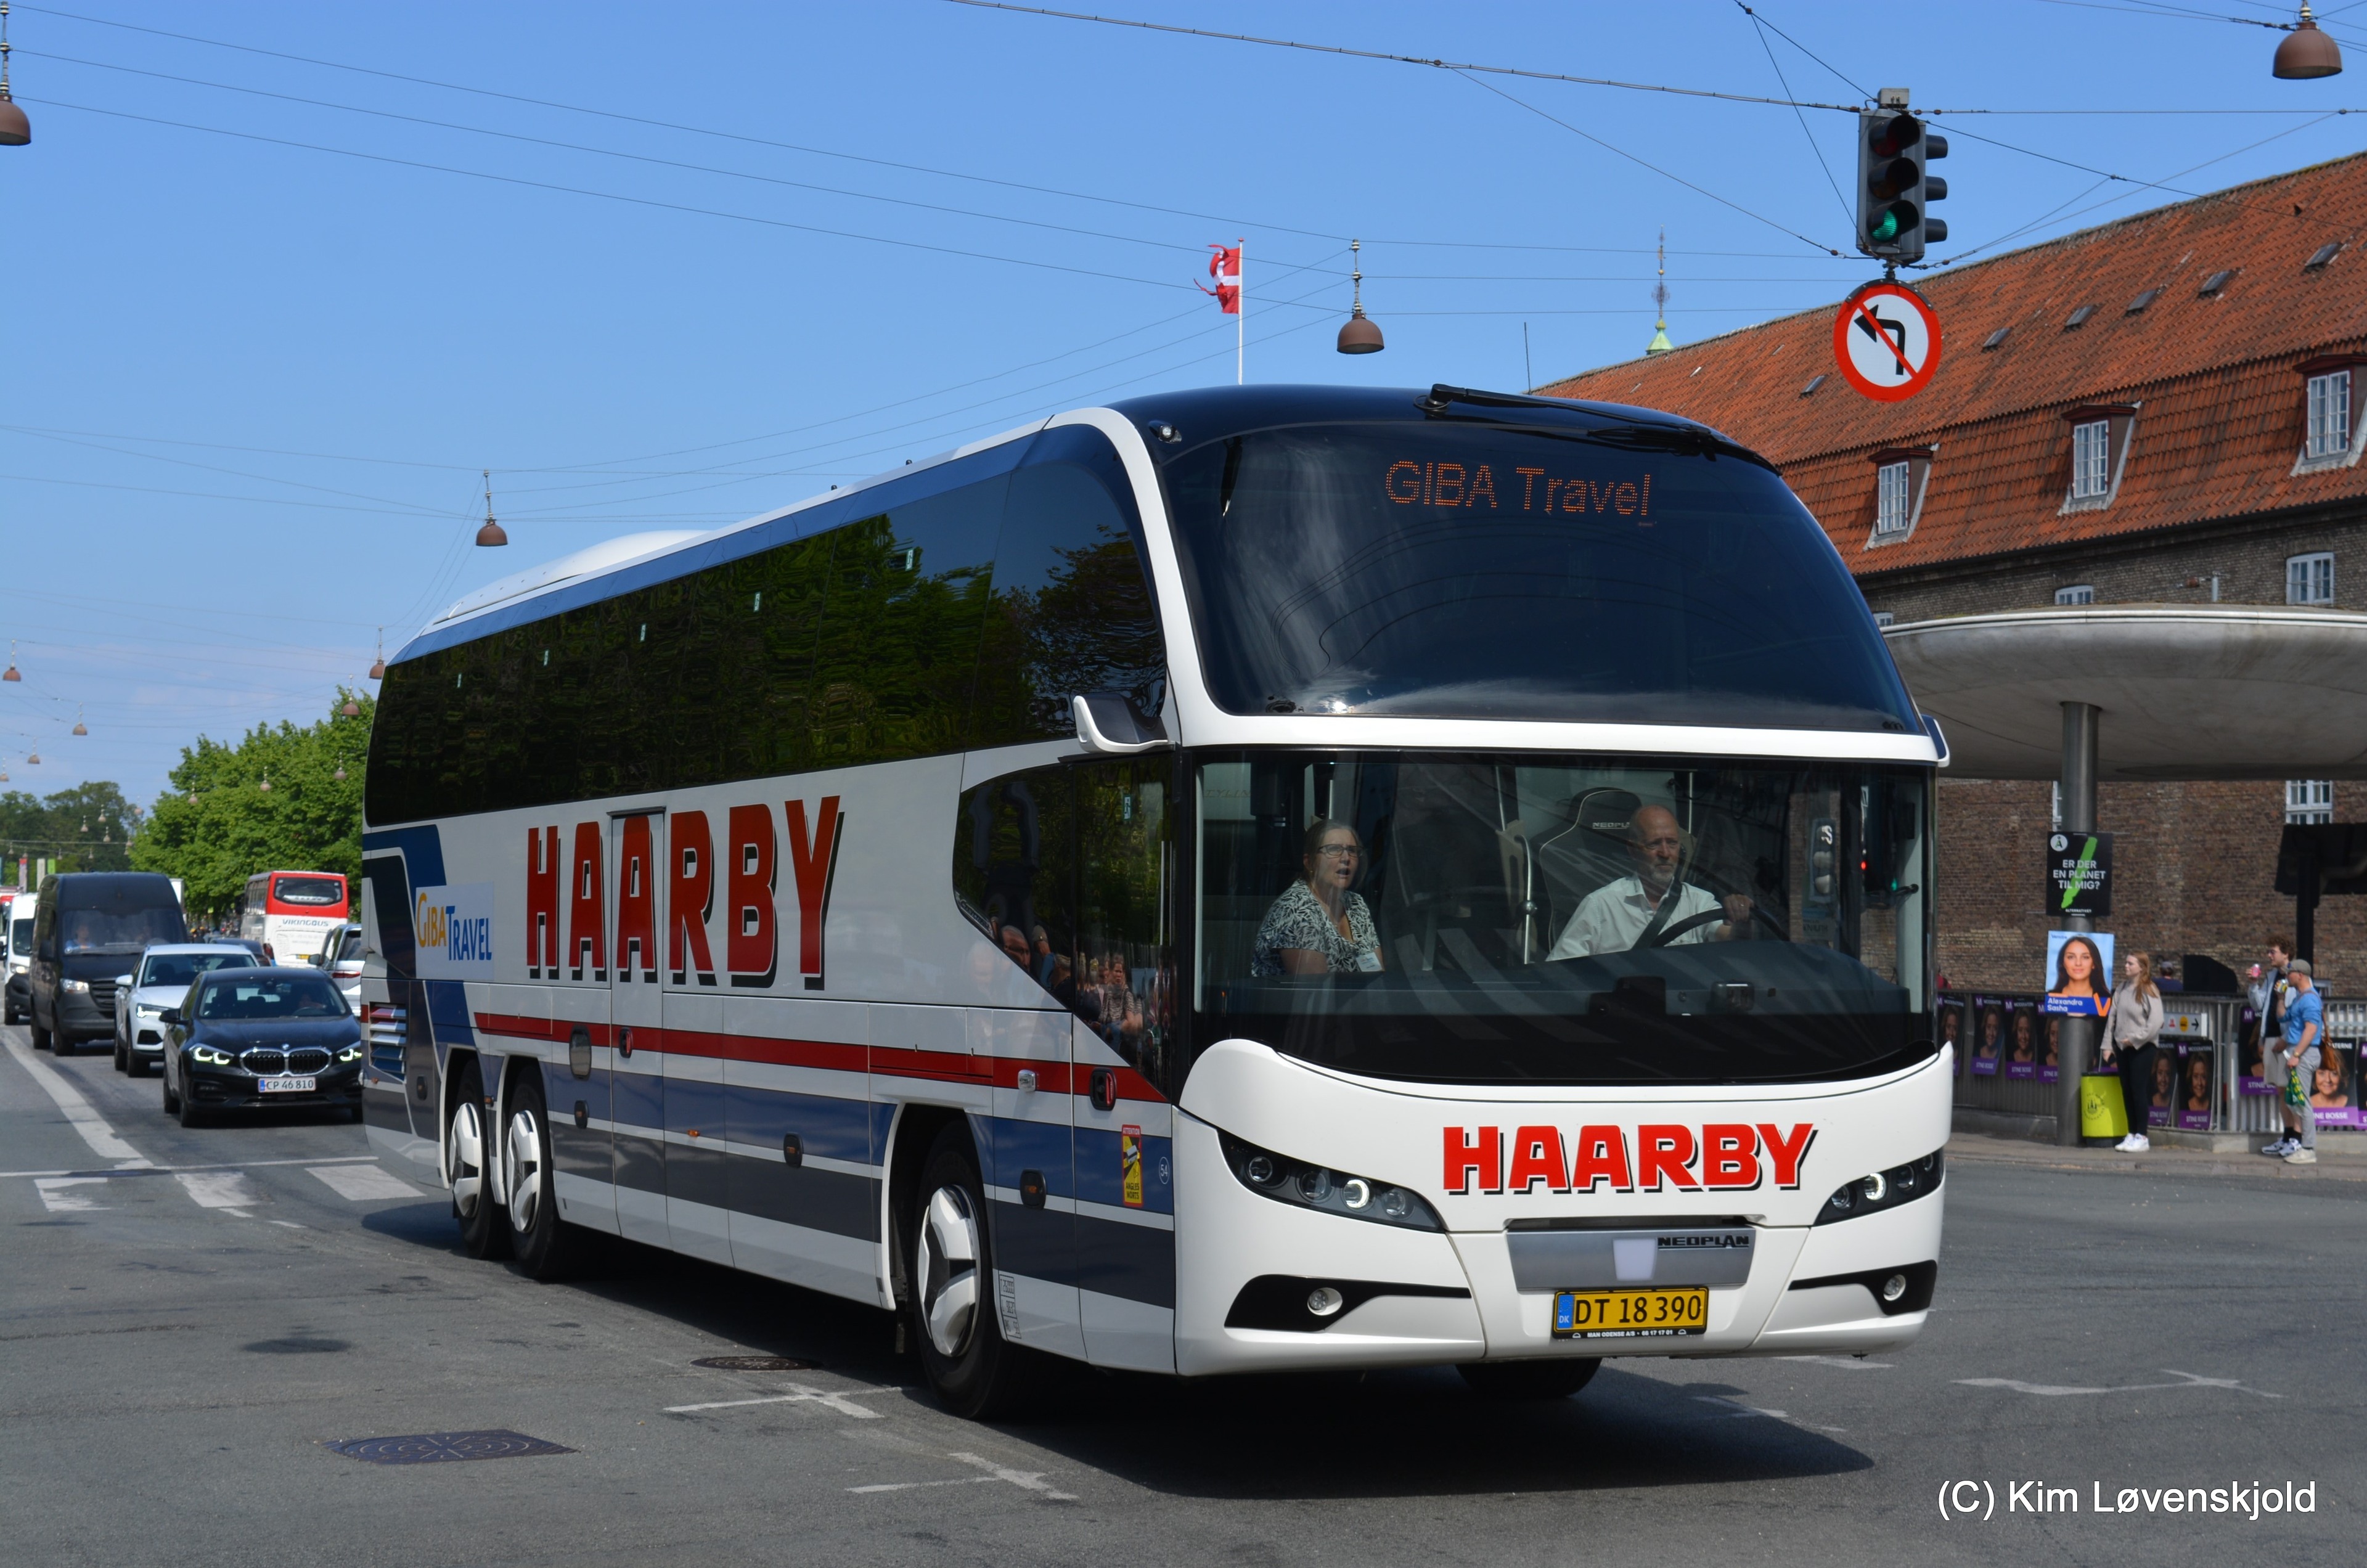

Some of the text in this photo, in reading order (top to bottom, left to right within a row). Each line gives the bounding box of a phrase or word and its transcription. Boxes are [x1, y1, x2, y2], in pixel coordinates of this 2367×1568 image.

[1386, 460, 1651, 515] GIBA Travel
[2062, 859, 2096, 868] ER DER
[2053, 870, 2106, 880] EN PLANET
[2058, 880, 2100, 889] TIL MIG?
[526, 795, 844, 990] HAARBY
[1976, 997, 1982, 1006] M
[2005, 1001, 2013, 1010] M
[2047, 997, 2083, 1006] Alexandra
[2093, 992, 2111, 1017] V
[2244, 1011, 2252, 1020] M
[2179, 1046, 2186, 1055] M
[266, 1080, 314, 1090] CP 46 810
[1443, 1123, 1819, 1194] HAARBY
[1160, 1164, 1168, 1177] 54
[1658, 1235, 1749, 1248] NEOPLAN
[1575, 1295, 1701, 1324] DT 18 390
[1559, 1315, 1569, 1323] DK
